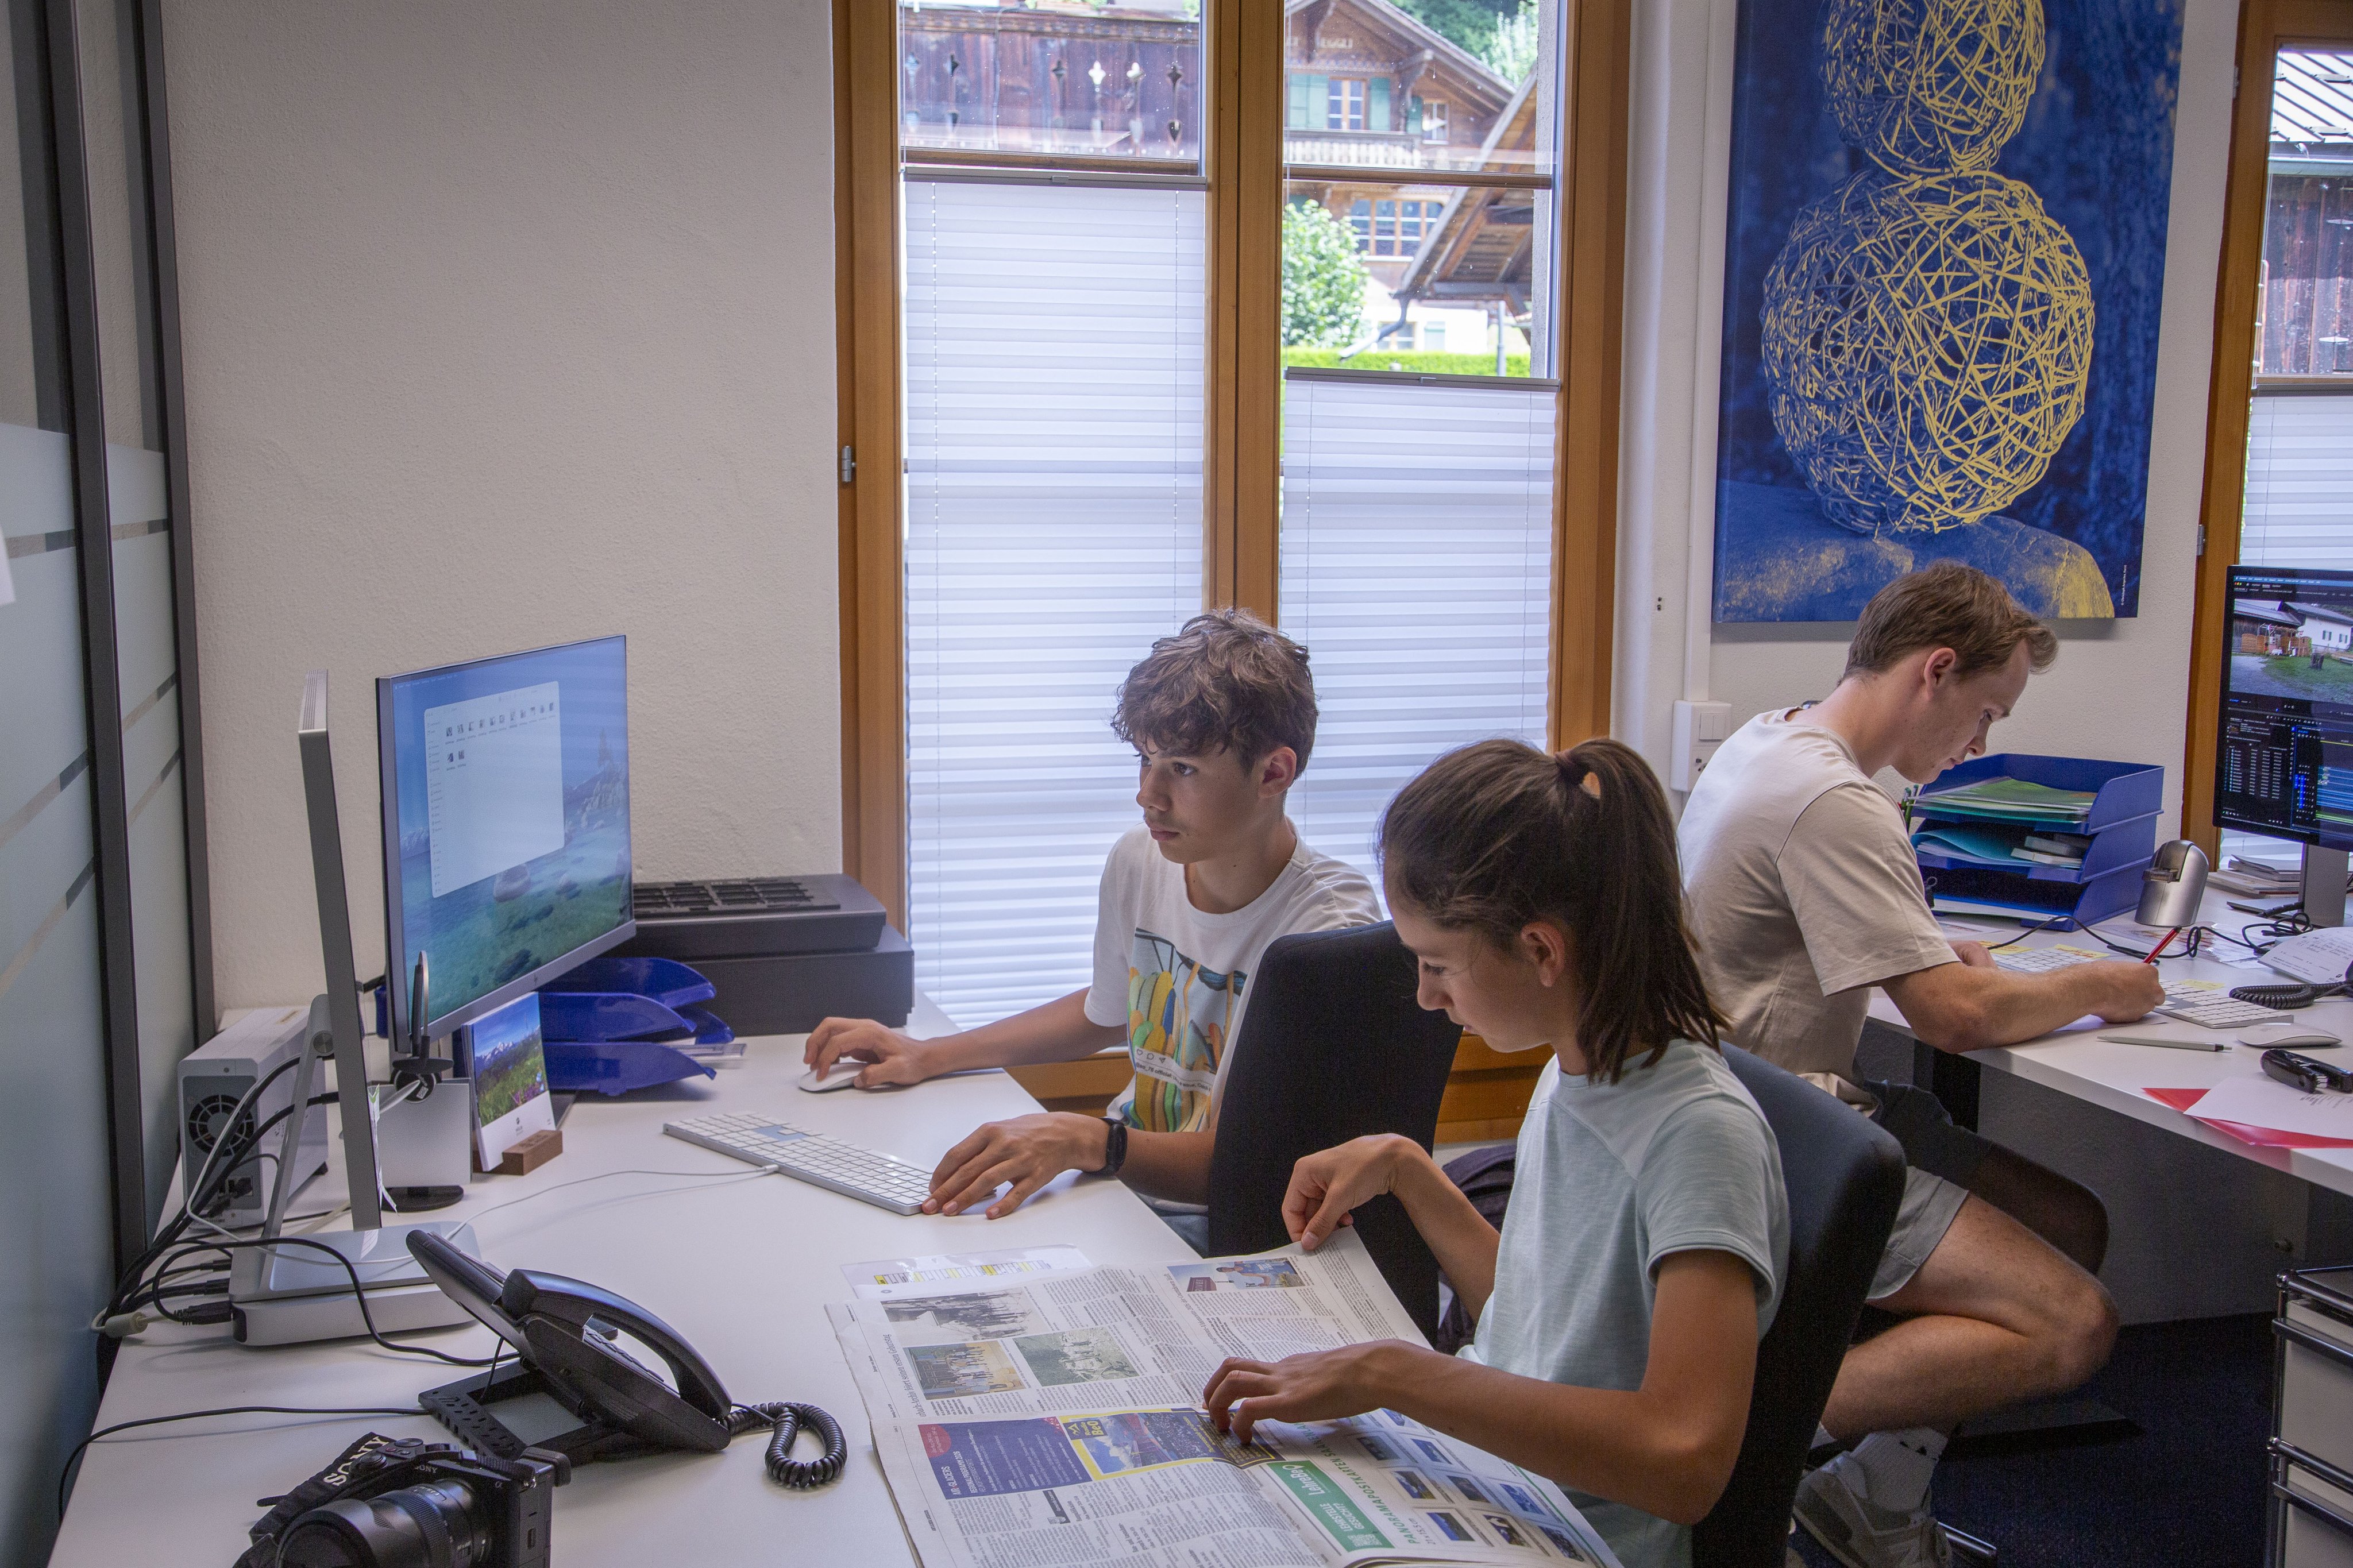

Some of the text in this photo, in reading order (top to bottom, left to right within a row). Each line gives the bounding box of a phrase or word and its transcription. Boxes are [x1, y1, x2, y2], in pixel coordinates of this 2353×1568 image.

[883, 1334, 897, 1354] Geburtstag
[892, 1354, 902, 1366] ersten
[1081, 1422, 1091, 1436] Radio
[1087, 1421, 1104, 1435] BeO
[415, 1465, 437, 1474] ONY
[1330, 1458, 1421, 1544] PANORAMAPOSTKARTEN
[1320, 1503, 1353, 1532] LEHRSTELLE
[1333, 1503, 1365, 1530] GESUCHT?
